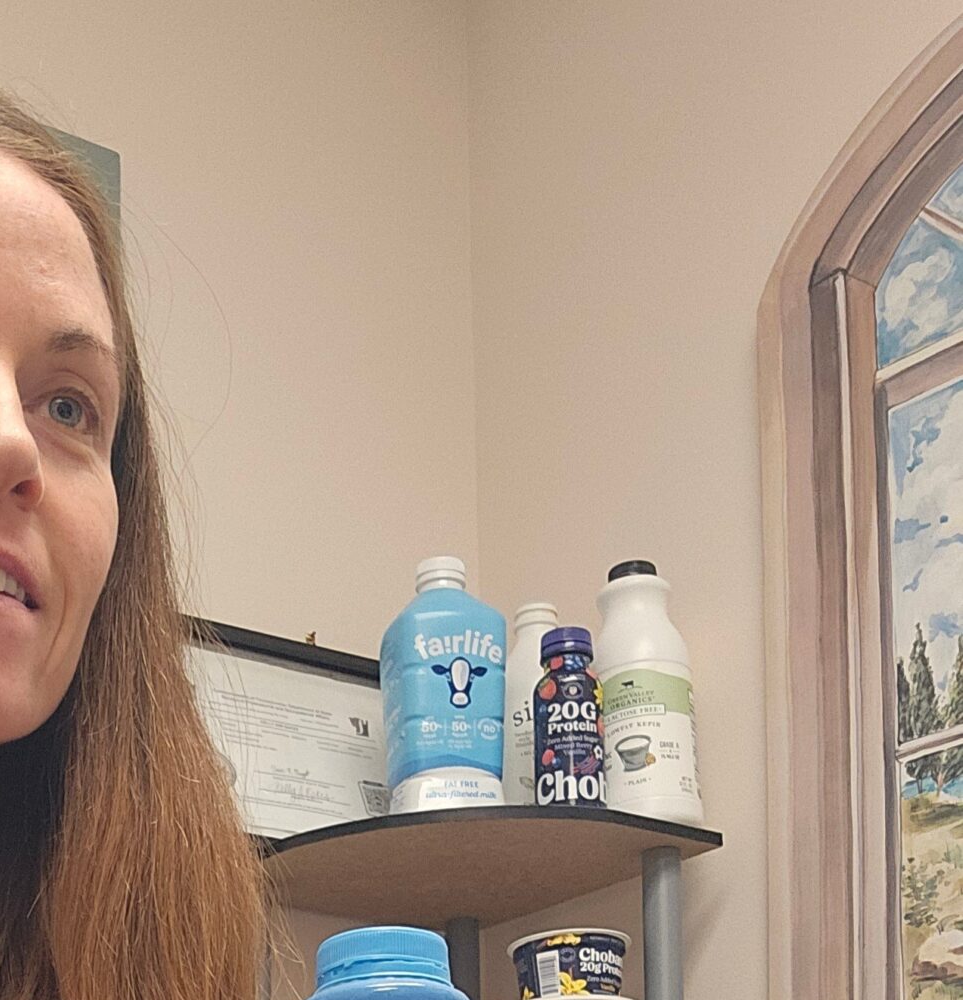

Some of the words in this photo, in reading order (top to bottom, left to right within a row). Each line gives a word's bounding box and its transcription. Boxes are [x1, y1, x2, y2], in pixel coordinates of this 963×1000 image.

[629, 690, 654, 699] VALLEY
[513, 701, 534, 727] si
[548, 701, 597, 722] 20G
[608, 710, 637, 722] LACTOSE
[548, 720, 597, 735] Protein
[636, 720, 661, 728] KEFIR
[461, 780, 479, 788] FREE
[580, 962, 602, 974] 20g
